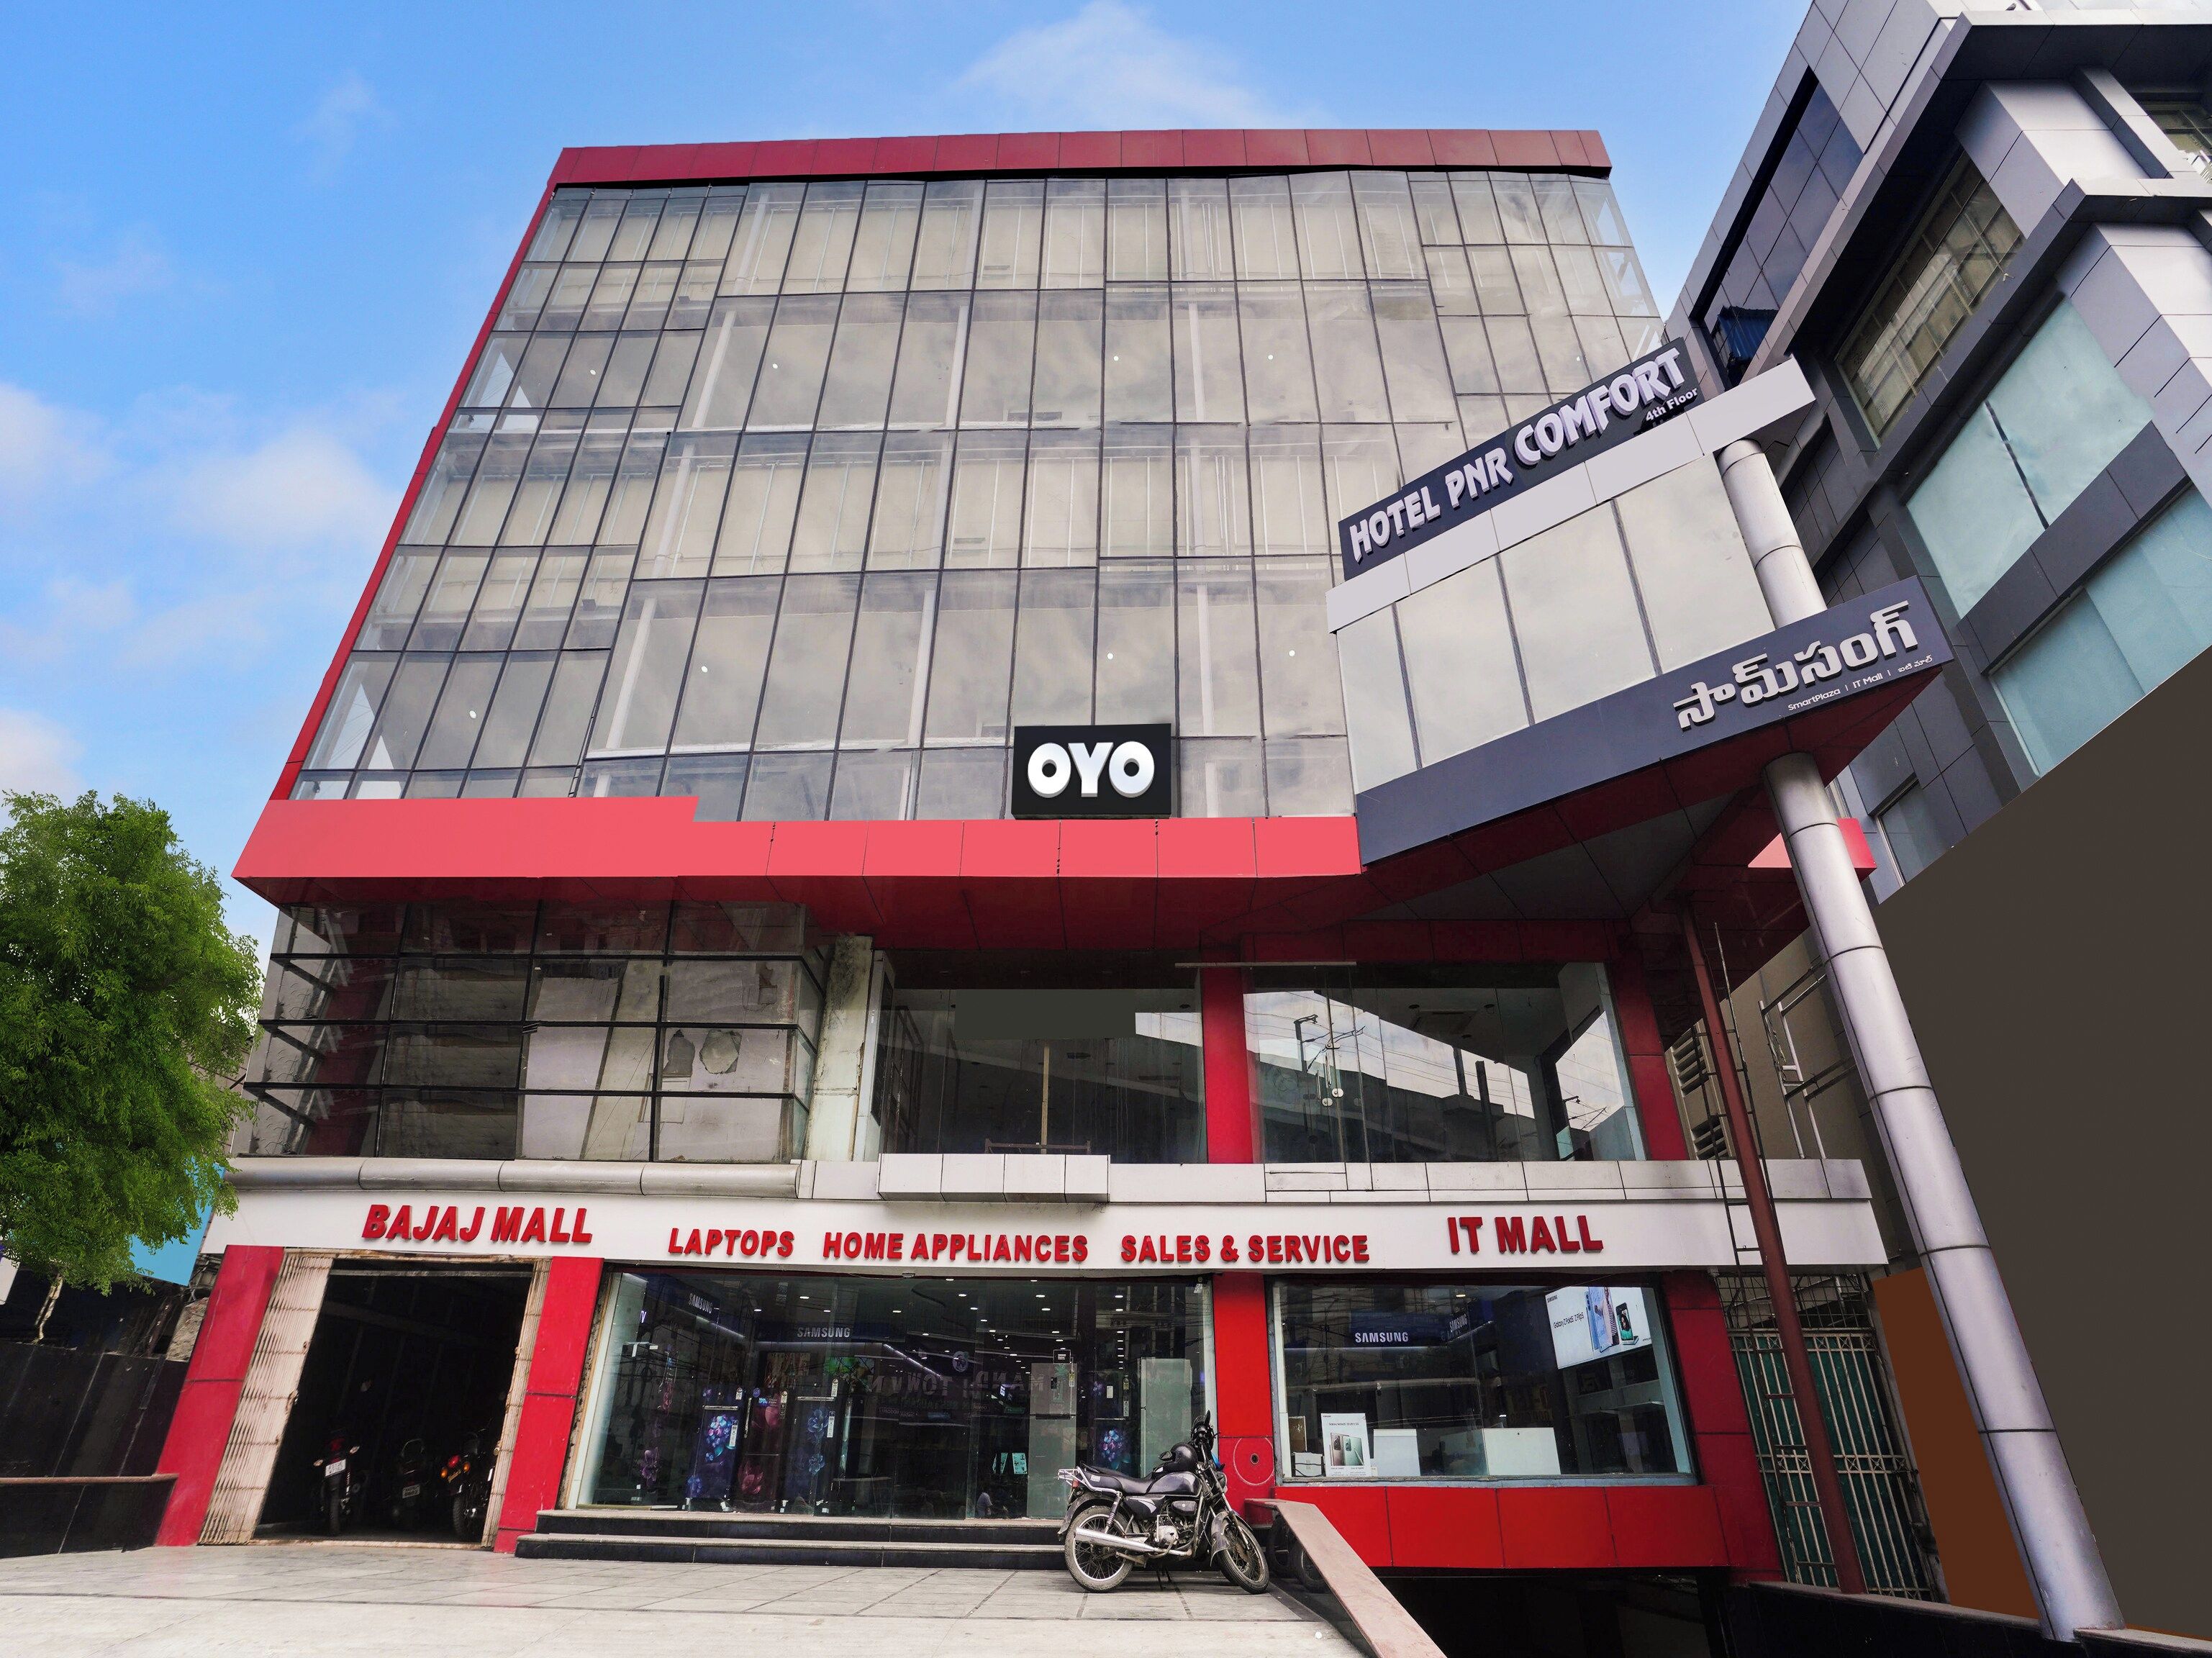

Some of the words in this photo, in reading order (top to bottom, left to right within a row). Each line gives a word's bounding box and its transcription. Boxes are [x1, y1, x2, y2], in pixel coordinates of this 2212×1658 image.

[1646, 406, 1667, 422] 4th
[1667, 387, 1697, 410] Floor
[1348, 485, 1441, 563] HOTEL
[1444, 447, 1513, 509] PNR
[1513, 347, 1685, 466] COMFORT
[1787, 688, 1841, 711] SmartPlaza
[1852, 679, 1862, 689] IT
[1863, 673, 1883, 685] Mall
[1027, 740, 1155, 799] OYO
[361, 1204, 486, 1243] BAJAJ
[490, 1207, 594, 1244] MALL
[1447, 1217, 1483, 1254] IT
[1495, 1215, 1604, 1253] MALL
[668, 1228, 794, 1258] LAPTOPS
[822, 1232, 905, 1260] HOME
[910, 1233, 1089, 1262] APPLIANCES
[1120, 1235, 1211, 1262] SALES
[1220, 1235, 1241, 1262] &
[1248, 1235, 1370, 1262] SERVICE
[688, 1292, 713, 1314] SAMSUNG
[797, 1326, 851, 1338] SAMSUNG
[1354, 1331, 1409, 1343] SAMSUNG
